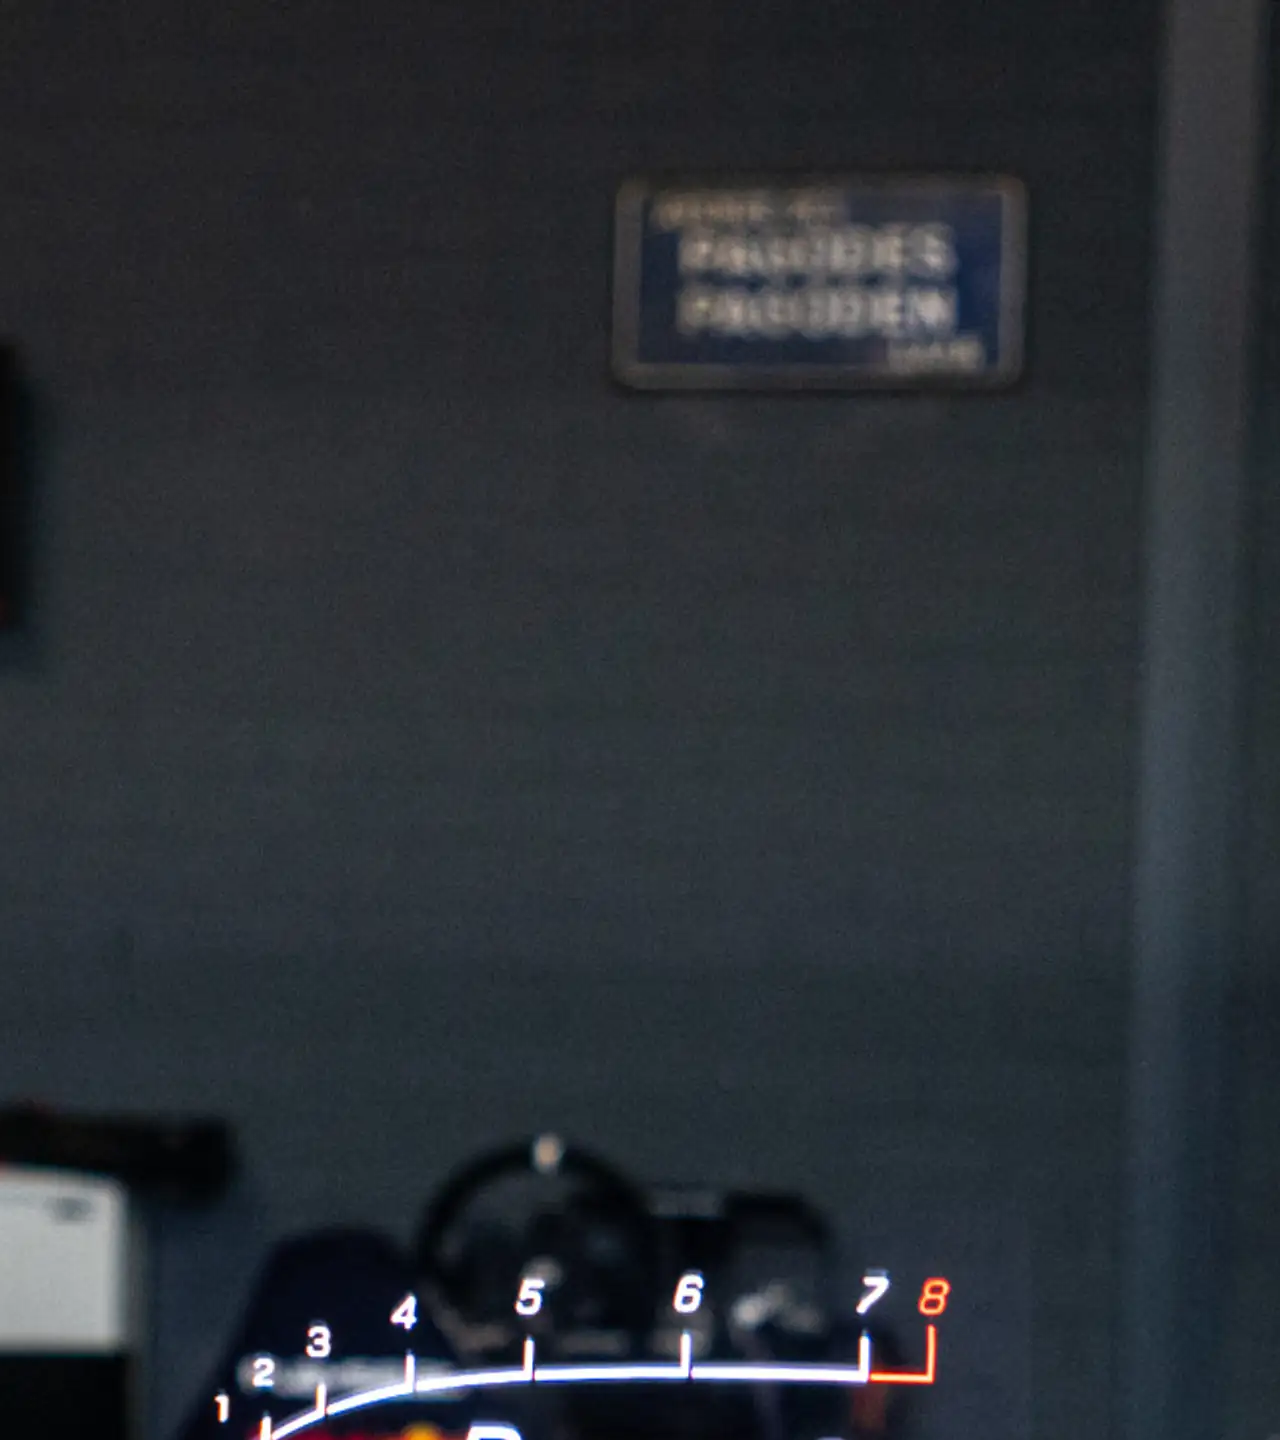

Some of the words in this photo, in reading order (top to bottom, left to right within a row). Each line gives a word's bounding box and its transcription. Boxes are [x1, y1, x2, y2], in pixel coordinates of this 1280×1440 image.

[214, 1393, 230, 1424] 1
[251, 1356, 276, 1389] 2
[305, 1325, 332, 1359] 3
[390, 1293, 418, 1330] 4
[515, 1277, 546, 1316] 5
[673, 1273, 705, 1314] 6
[856, 1275, 890, 1315] 7
[917, 1277, 951, 1316] 8
